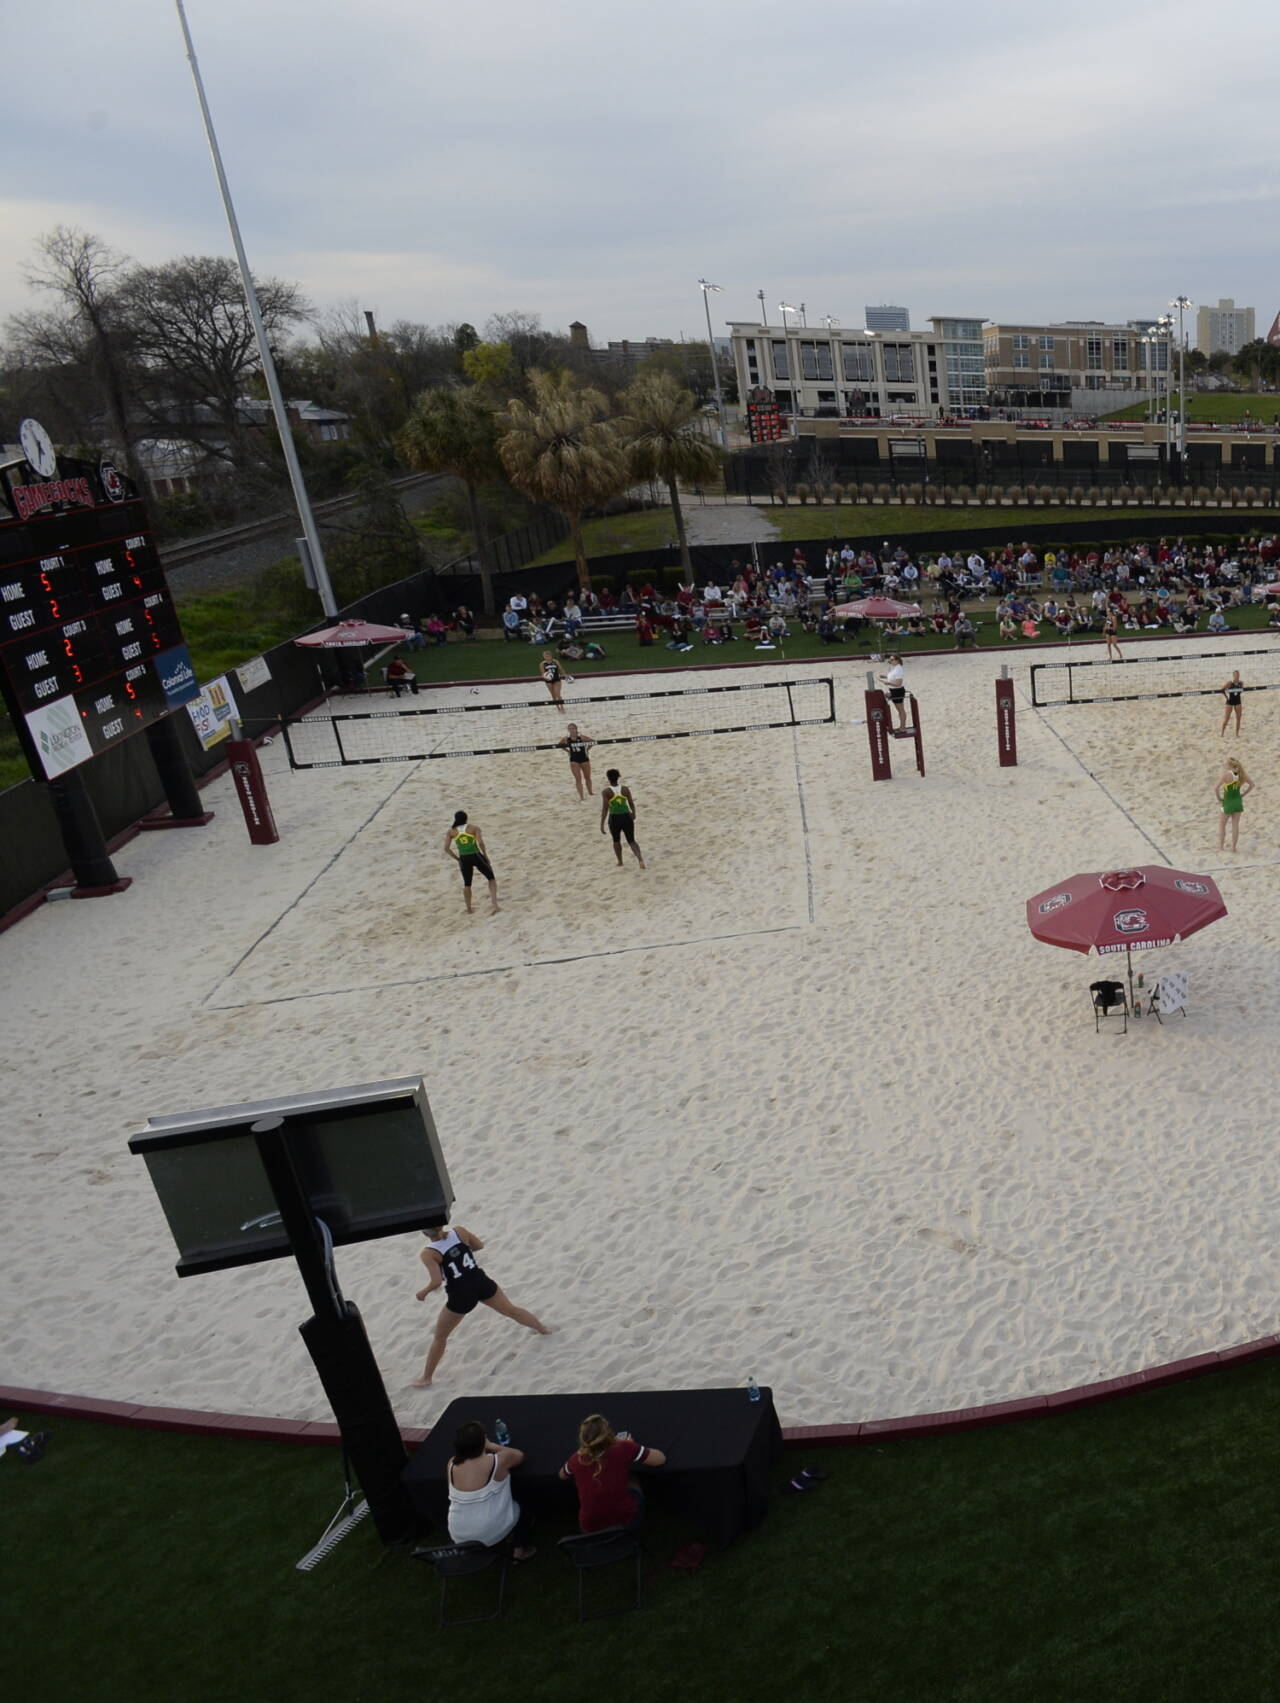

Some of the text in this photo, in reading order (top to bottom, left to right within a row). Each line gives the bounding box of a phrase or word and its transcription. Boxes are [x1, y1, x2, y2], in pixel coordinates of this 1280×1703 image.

[12, 476, 95, 520] GAMECOCKS
[125, 537, 141, 550] COURT
[40, 557, 60, 572] COURT
[95, 558, 115, 575] HOME
[125, 551, 136, 568] 5
[40, 572, 52, 592] 5
[133, 576, 143, 589] 4
[0, 582, 26, 603] HOME
[102, 582, 122, 601] GUEST
[49, 599, 62, 618] 2
[143, 609, 154, 626] 5
[9, 609, 36, 631] GUEST
[115, 617, 135, 636] HOME
[63, 621, 82, 638] COURT
[63, 639, 74, 657] 2
[151, 631, 161, 648] 5
[122, 641, 142, 661] GUEST
[25, 650, 50, 671] HOME
[72, 664, 84, 682] 3
[125, 667, 142, 682] COURT
[34, 675, 60, 699] GUEST
[125, 682, 137, 700] 5
[94, 693, 116, 715] HOME
[102, 717, 124, 740] GUEST
[1099, 937, 1170, 955] SOUTH CAROLINA
[448, 1251, 476, 1280] 14
